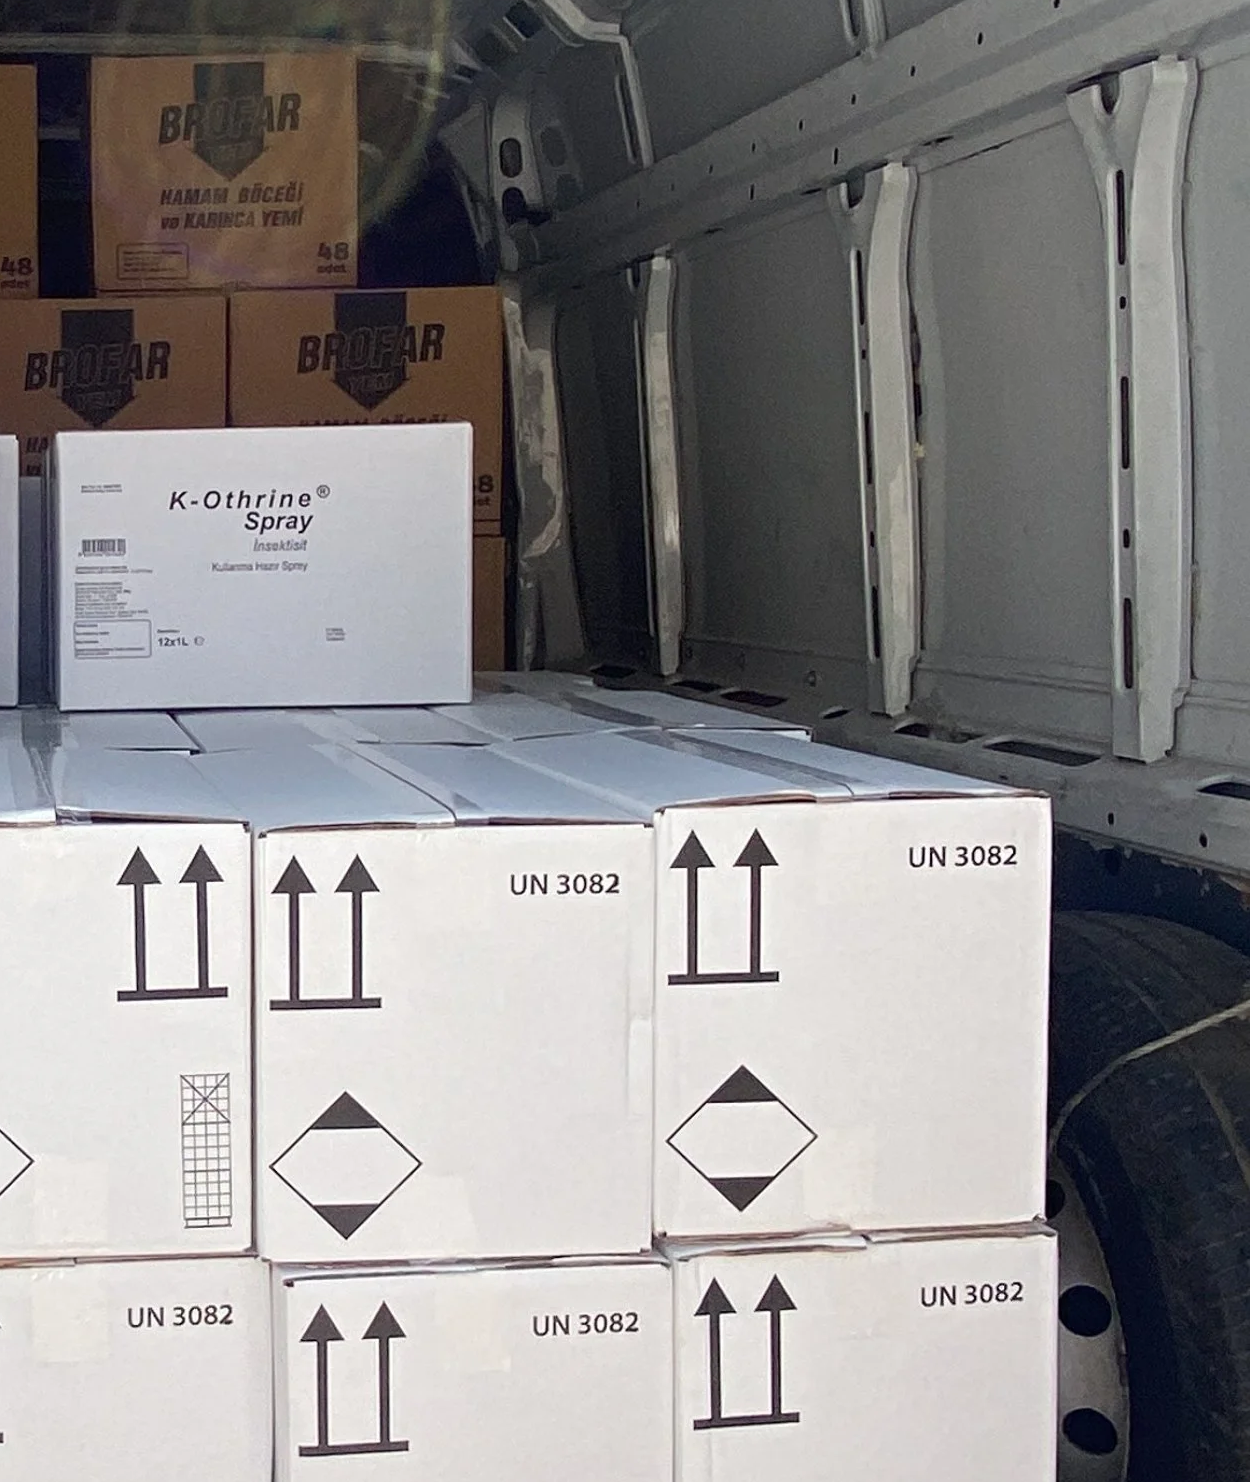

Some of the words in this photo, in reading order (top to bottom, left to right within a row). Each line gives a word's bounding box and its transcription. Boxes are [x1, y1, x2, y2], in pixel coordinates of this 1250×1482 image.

[158, 92, 302, 145] BROFAR
[159, 187, 229, 206] HAMAM
[183, 212, 256, 230] KARINCA
[316, 241, 350, 262] 48
[0, 256, 34, 277] 48
[297, 322, 446, 375] BROFAR
[24, 340, 172, 392] BROFAR
[244, 511, 313, 535] Spray
[156, 636, 190, 648] 12x1L
[909, 846, 946, 868] UN
[954, 845, 1018, 867] 3082
[511, 874, 548, 895] UN
[557, 873, 619, 895] 3082
[921, 1285, 956, 1307] UN
[964, 1282, 1023, 1304] 3082
[128, 1307, 164, 1328] UN
[173, 1304, 233, 1326] 3082
[533, 1315, 570, 1336] UN
[578, 1312, 639, 1334] 3082
